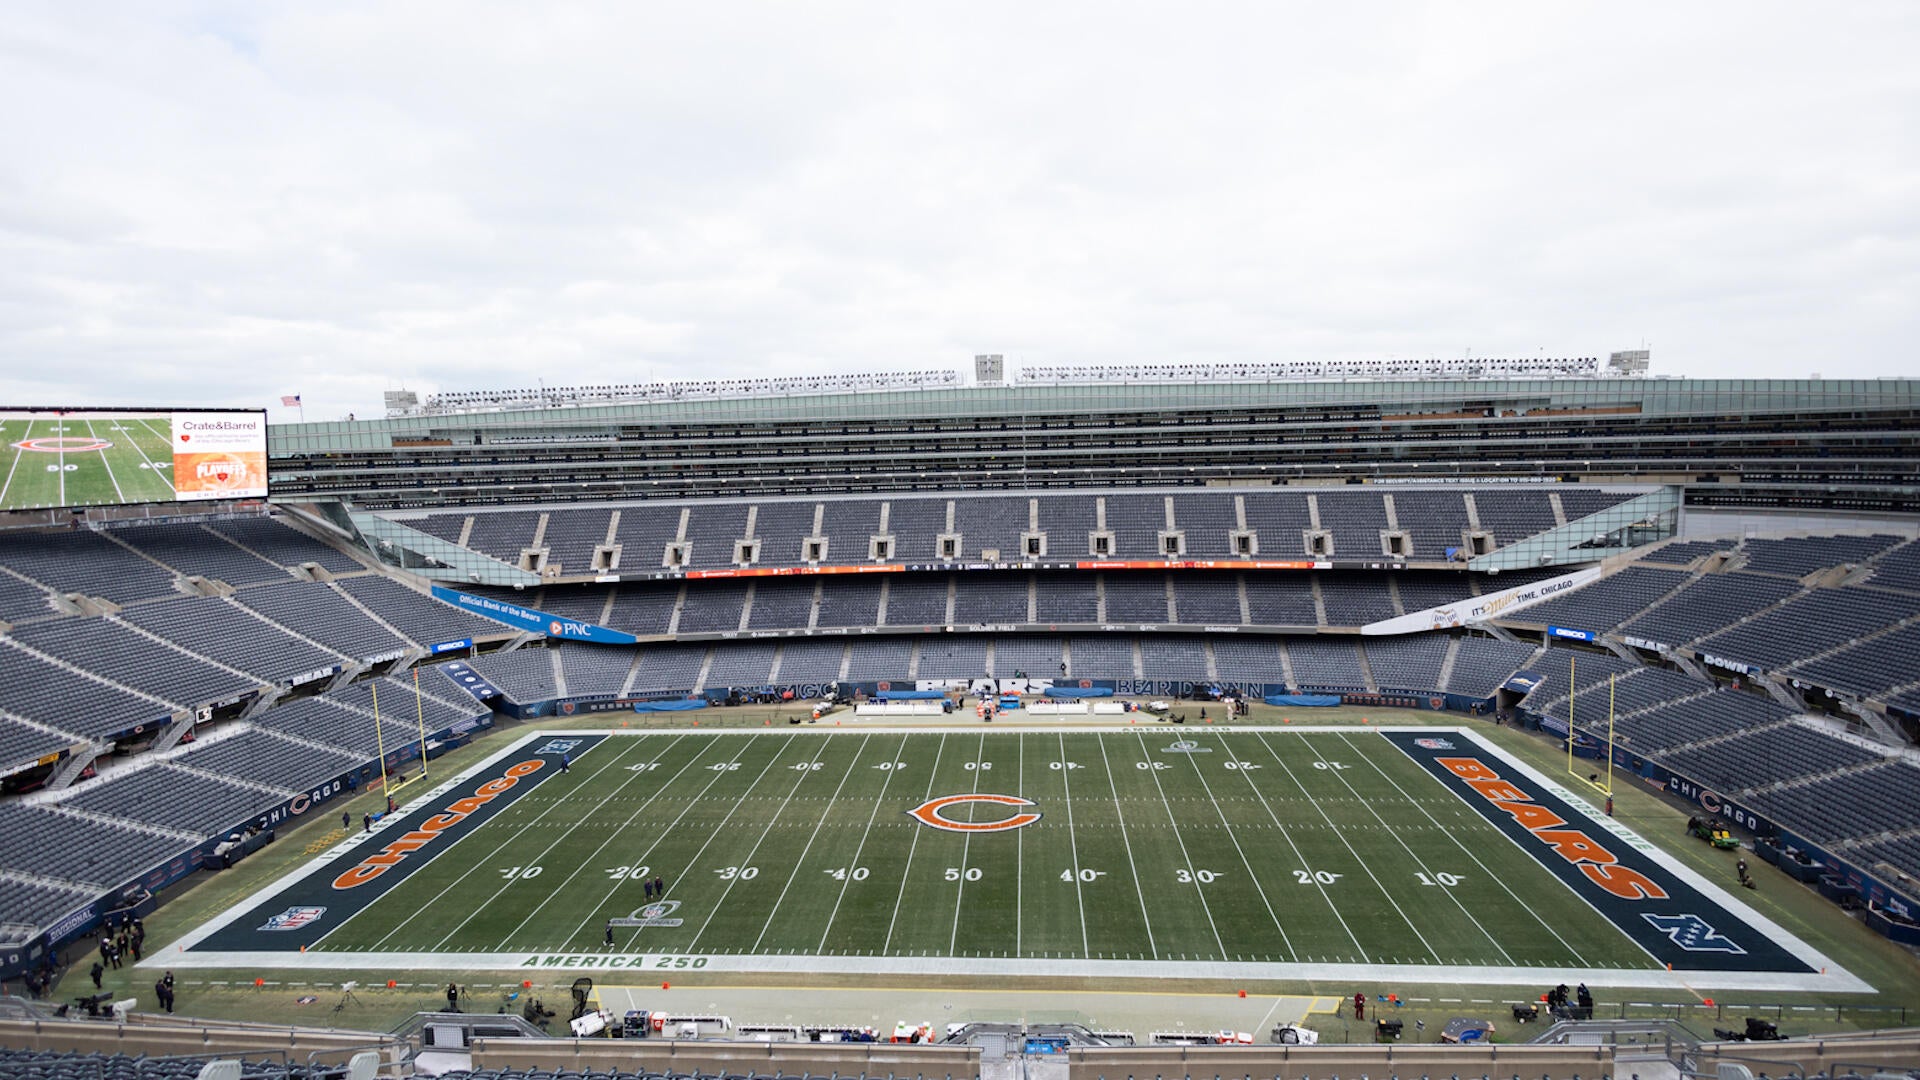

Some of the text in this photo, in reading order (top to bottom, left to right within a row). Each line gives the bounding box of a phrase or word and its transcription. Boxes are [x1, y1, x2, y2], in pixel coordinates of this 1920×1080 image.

[183, 421, 256, 430] Crate&Barrel
[1483, 588, 1520, 615] Miller
[1517, 592, 1539, 603] TIME,
[1541, 580, 1573, 595] CHICAGO
[459, 594, 541, 622] Official Bank of the Bears
[564, 623, 591, 636] PNC
[438, 641, 465, 651] GEICO
[1704, 654, 1748, 673] DOWN
[293, 667, 333, 686] BEAR
[915, 679, 1054, 695] BEARS
[1115, 680, 1171, 696] BEAR
[1671, 777, 1757, 830] CHICAGO
[331, 759, 546, 890] CHICAGO
[1433, 757, 1670, 900] BEARS
[1604, 824, 1655, 850] LOVE
[502, 866, 543, 879] 10
[609, 866, 651, 879] 20
[720, 867, 759, 880] 30
[831, 867, 870, 881] 40
[944, 867, 983, 881] 50
[1060, 868, 1097, 882] 40
[1176, 869, 1216, 883] 30
[1293, 870, 1336, 884] 20
[1414, 871, 1460, 887] 10
[49, 909, 93, 940] DIVISIONAL
[521, 955, 708, 969] AMERICA 250
